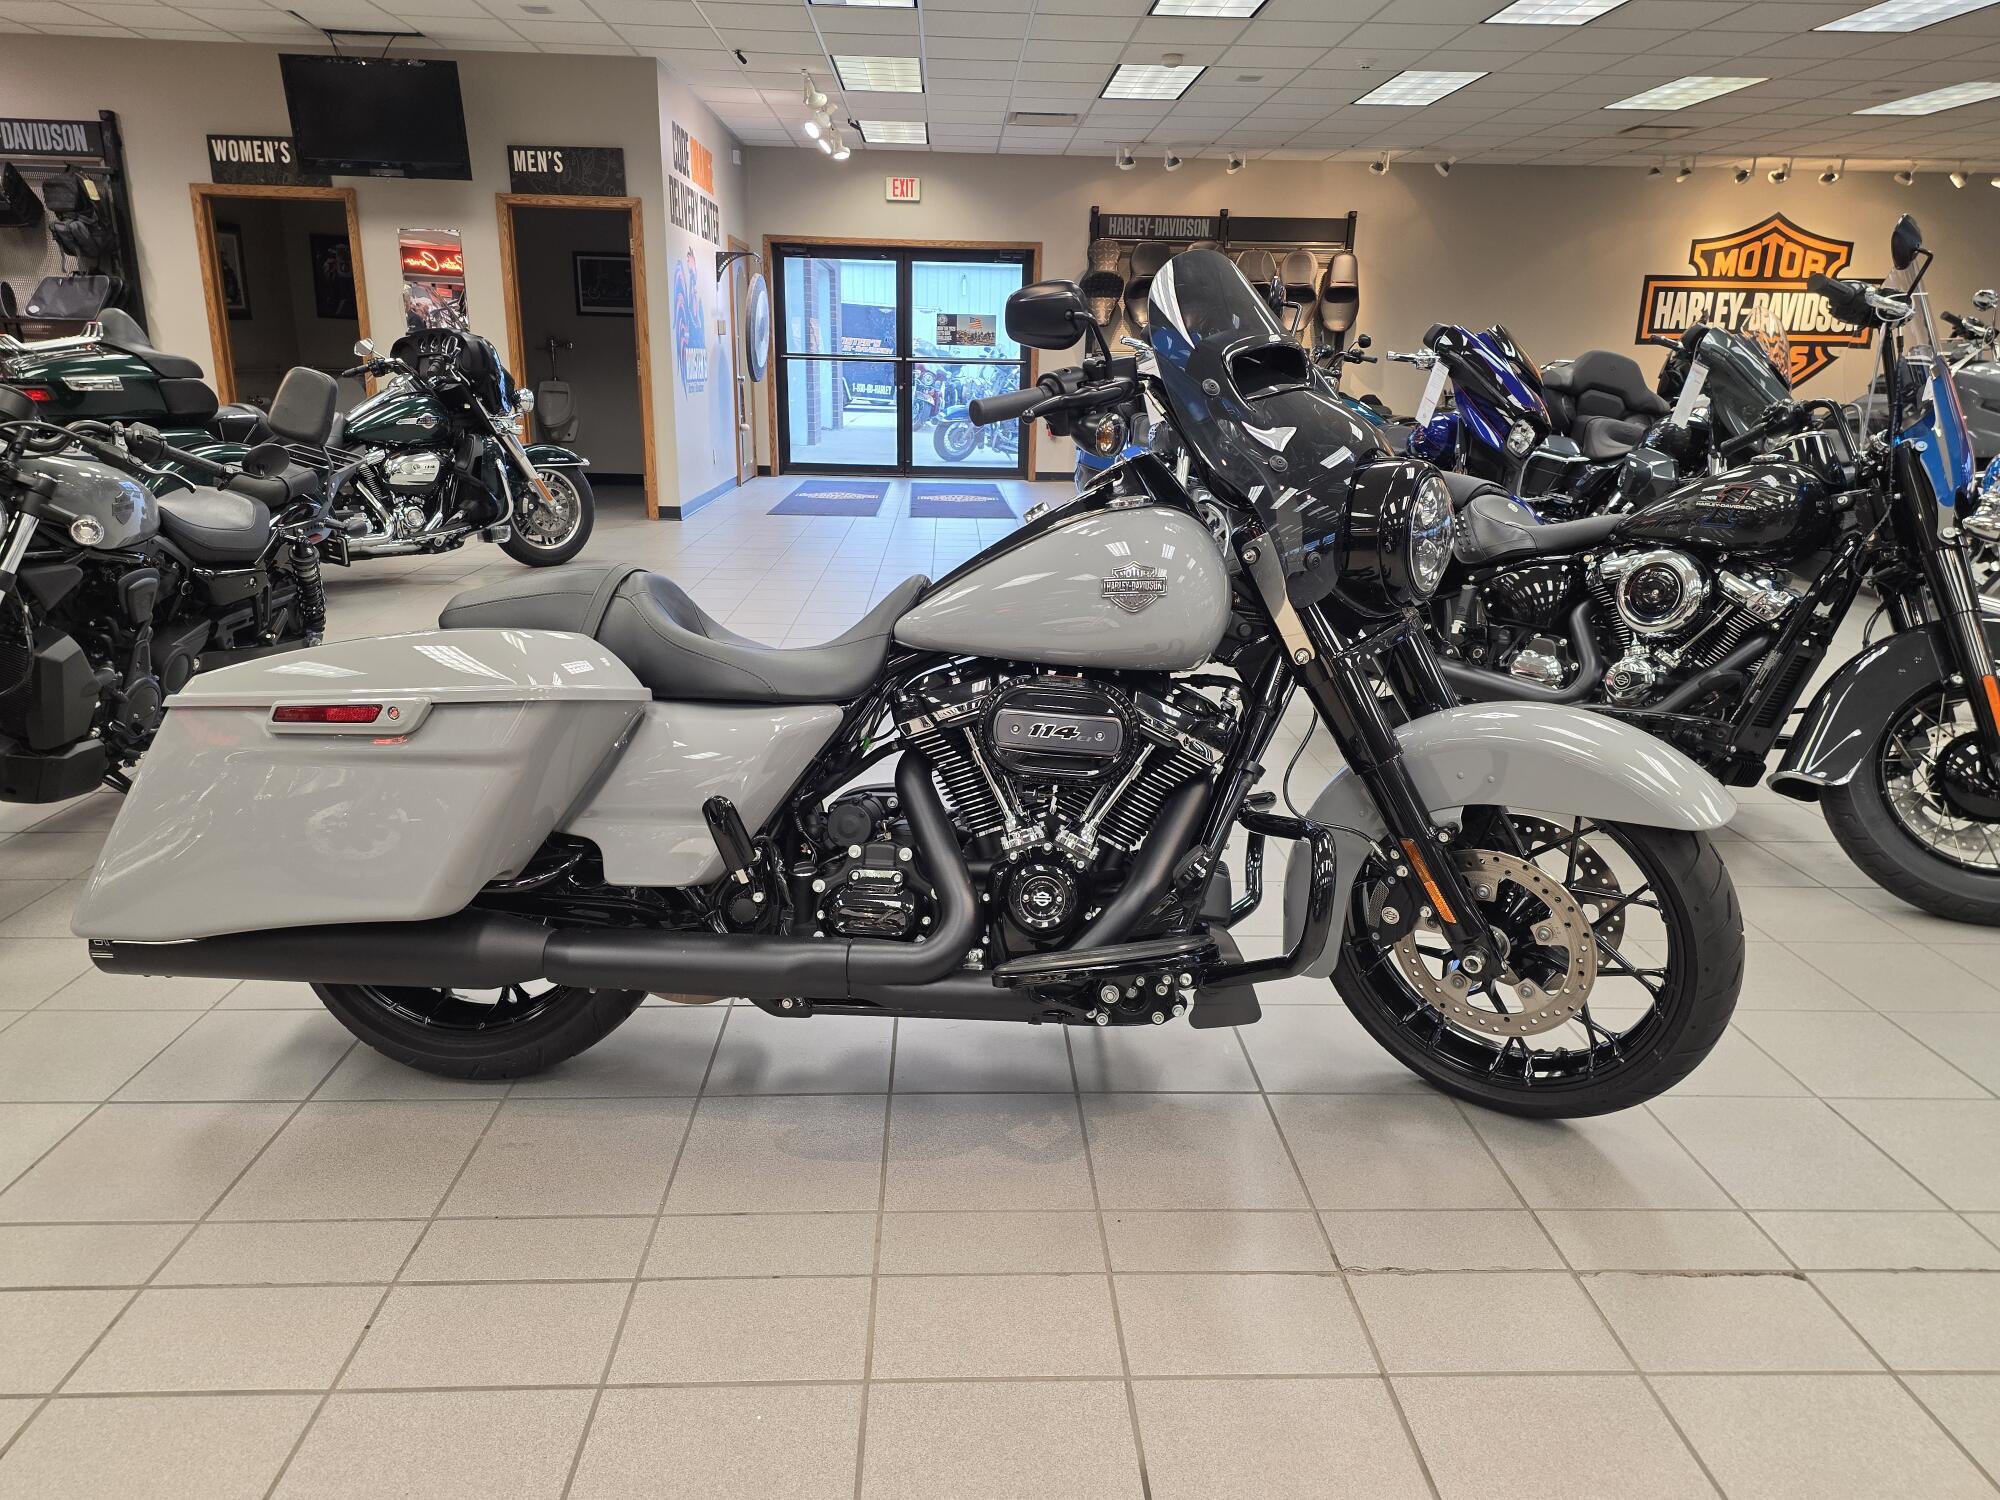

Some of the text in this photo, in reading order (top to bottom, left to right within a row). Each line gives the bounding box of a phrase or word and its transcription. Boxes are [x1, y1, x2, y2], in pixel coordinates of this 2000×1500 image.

[0, 121, 89, 152] DAVIDSON
[211, 138, 291, 164] WOMEN'S
[512, 149, 564, 173] MEN'S
[671, 119, 690, 181] CODE
[892, 178, 915, 198] EXIT
[668, 173, 720, 247] DELIVERY CENTER
[1108, 216, 1210, 238] HARLEY-DAVIDSON
[1712, 232, 1827, 279] MOTOR
[1653, 290, 1858, 333] HARLEY-DAVIDS
[1695, 500, 1757, 511] HARLEY-DAVIDSON
[1106, 580, 1163, 591] HARLEY-DAVIDSON
[1028, 723, 1081, 740] 114
